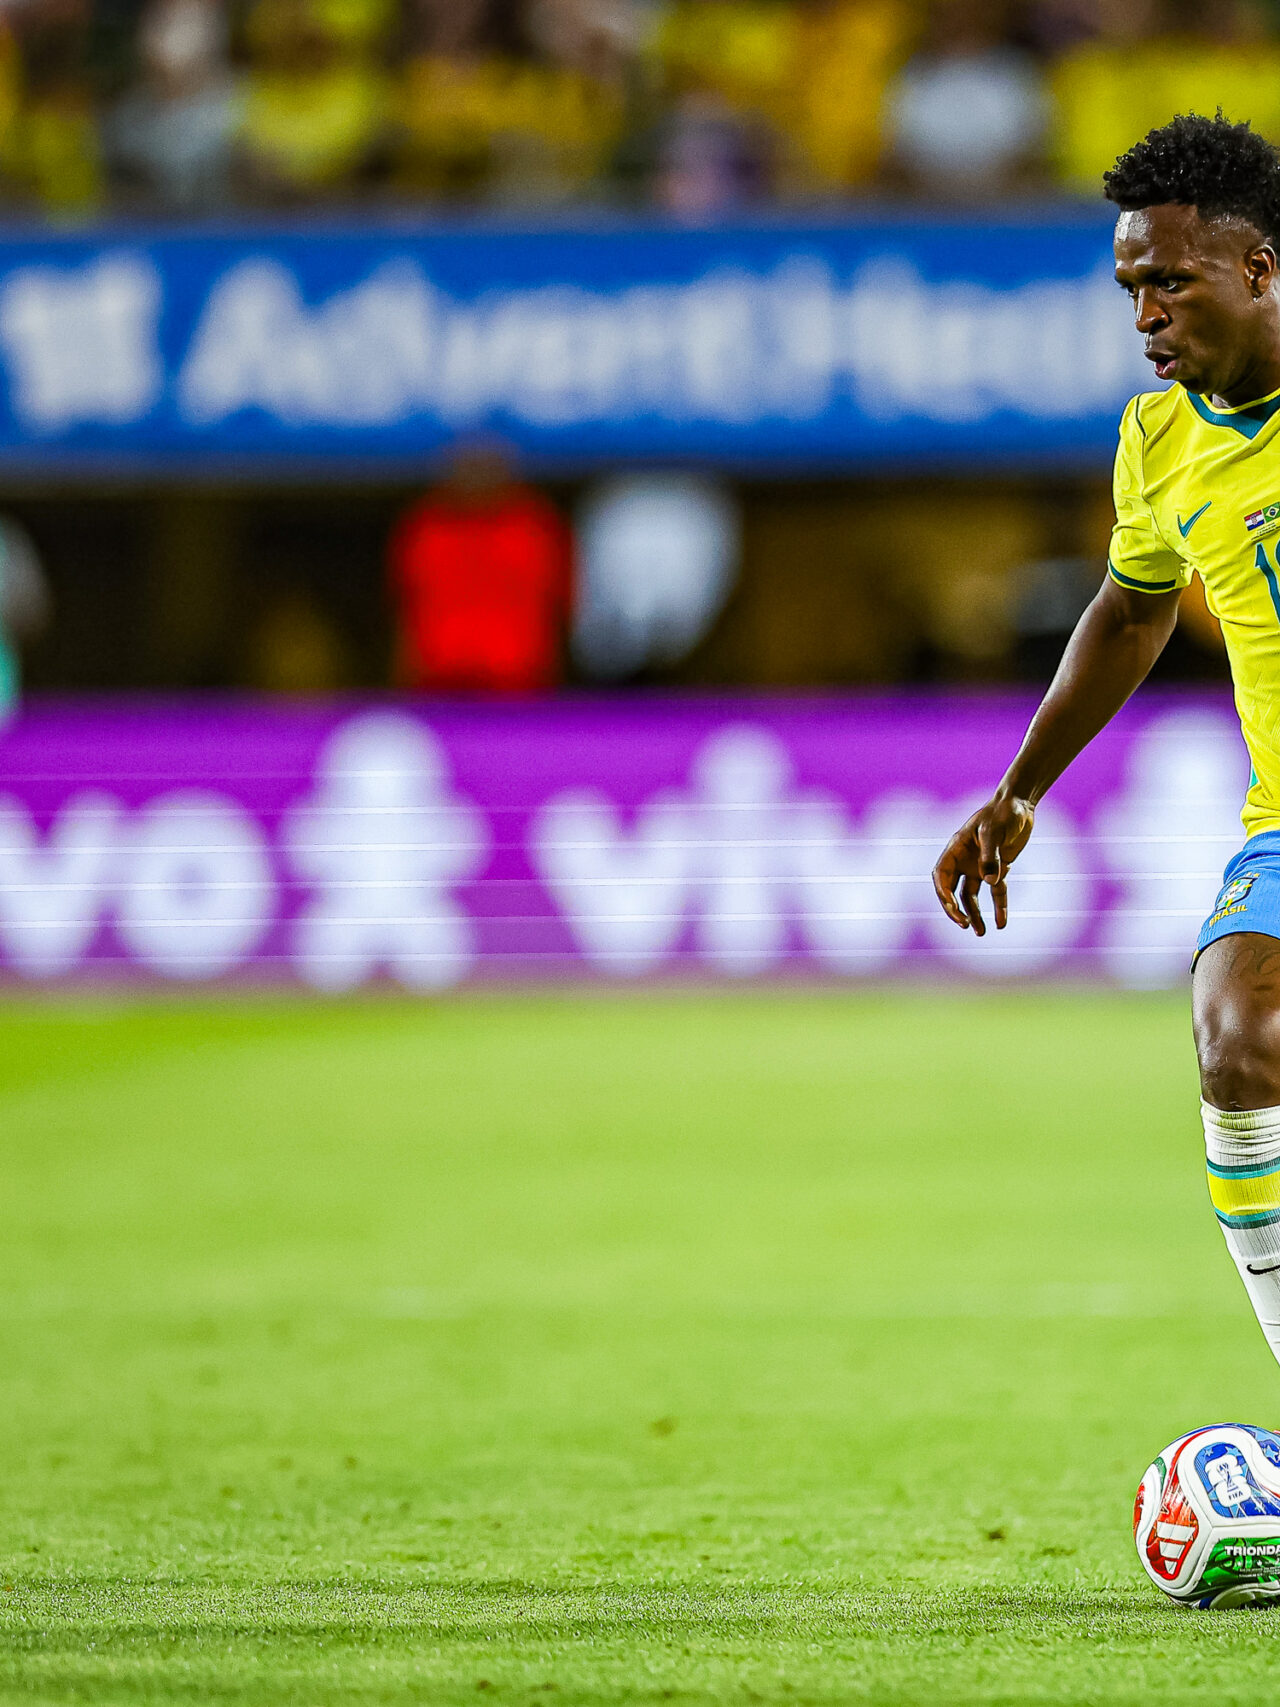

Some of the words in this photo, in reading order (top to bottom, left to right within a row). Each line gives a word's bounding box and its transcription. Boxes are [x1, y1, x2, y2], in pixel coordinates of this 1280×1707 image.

[530, 724, 1090, 974] vivo
[1209, 904, 1248, 928] BRASIL
[1228, 1491, 1243, 1500] FIFA
